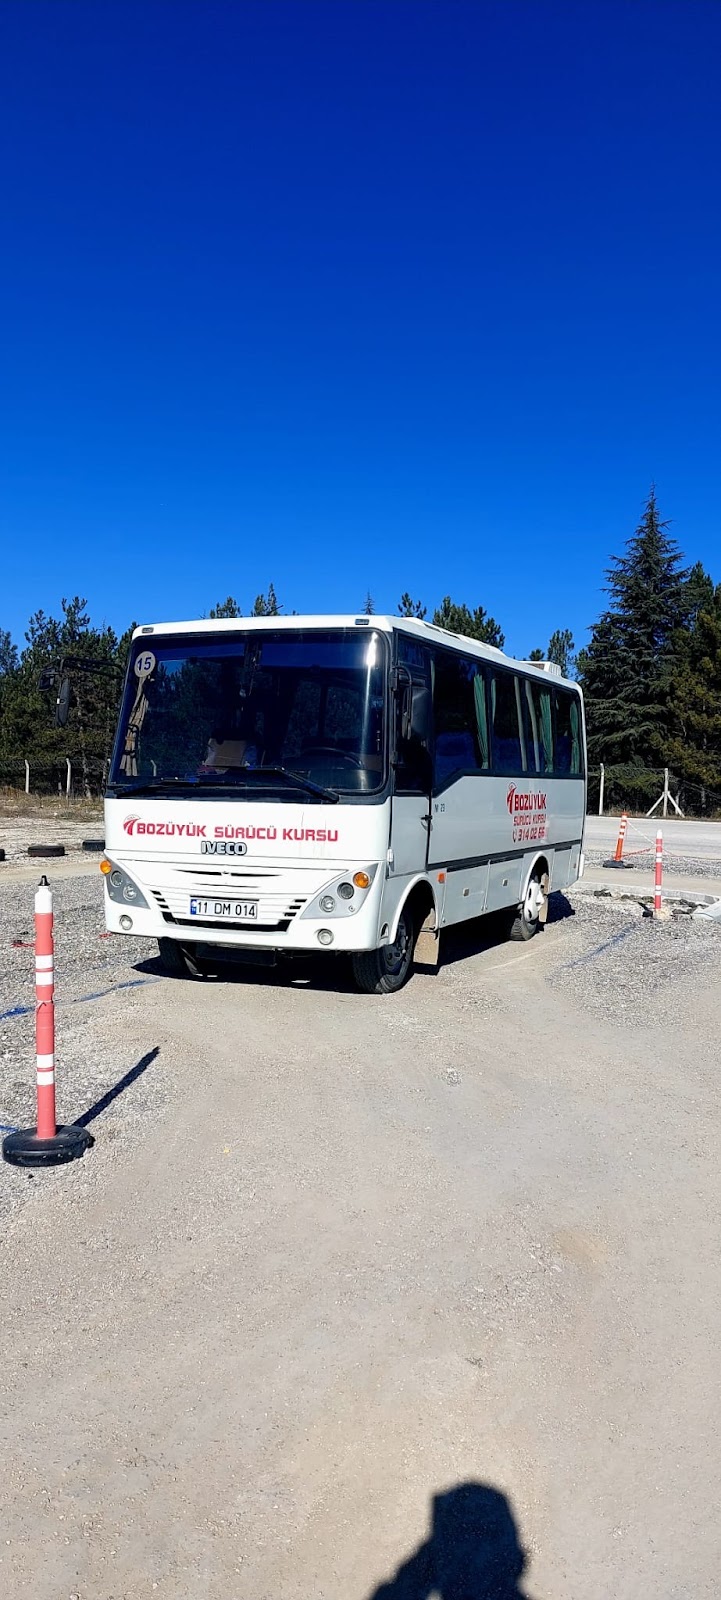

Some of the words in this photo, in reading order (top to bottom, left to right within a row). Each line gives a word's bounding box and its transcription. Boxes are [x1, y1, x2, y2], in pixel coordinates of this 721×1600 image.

[137, 656, 152, 671] 15
[514, 790, 547, 811] BOZÜYÜK
[513, 813, 531, 826] SÜRÜCÜ
[532, 813, 547, 825] KURSU
[136, 821, 207, 838] BOZÜYÜK
[214, 824, 277, 841] SÜRÜCÜ
[282, 828, 339, 842] KURSU
[518, 828, 529, 842] 314
[529, 827, 537, 840] 02
[200, 840, 247, 856] IVECO
[198, 901, 208, 914] 11
[214, 902, 231, 915] DM
[235, 904, 255, 917] 014
